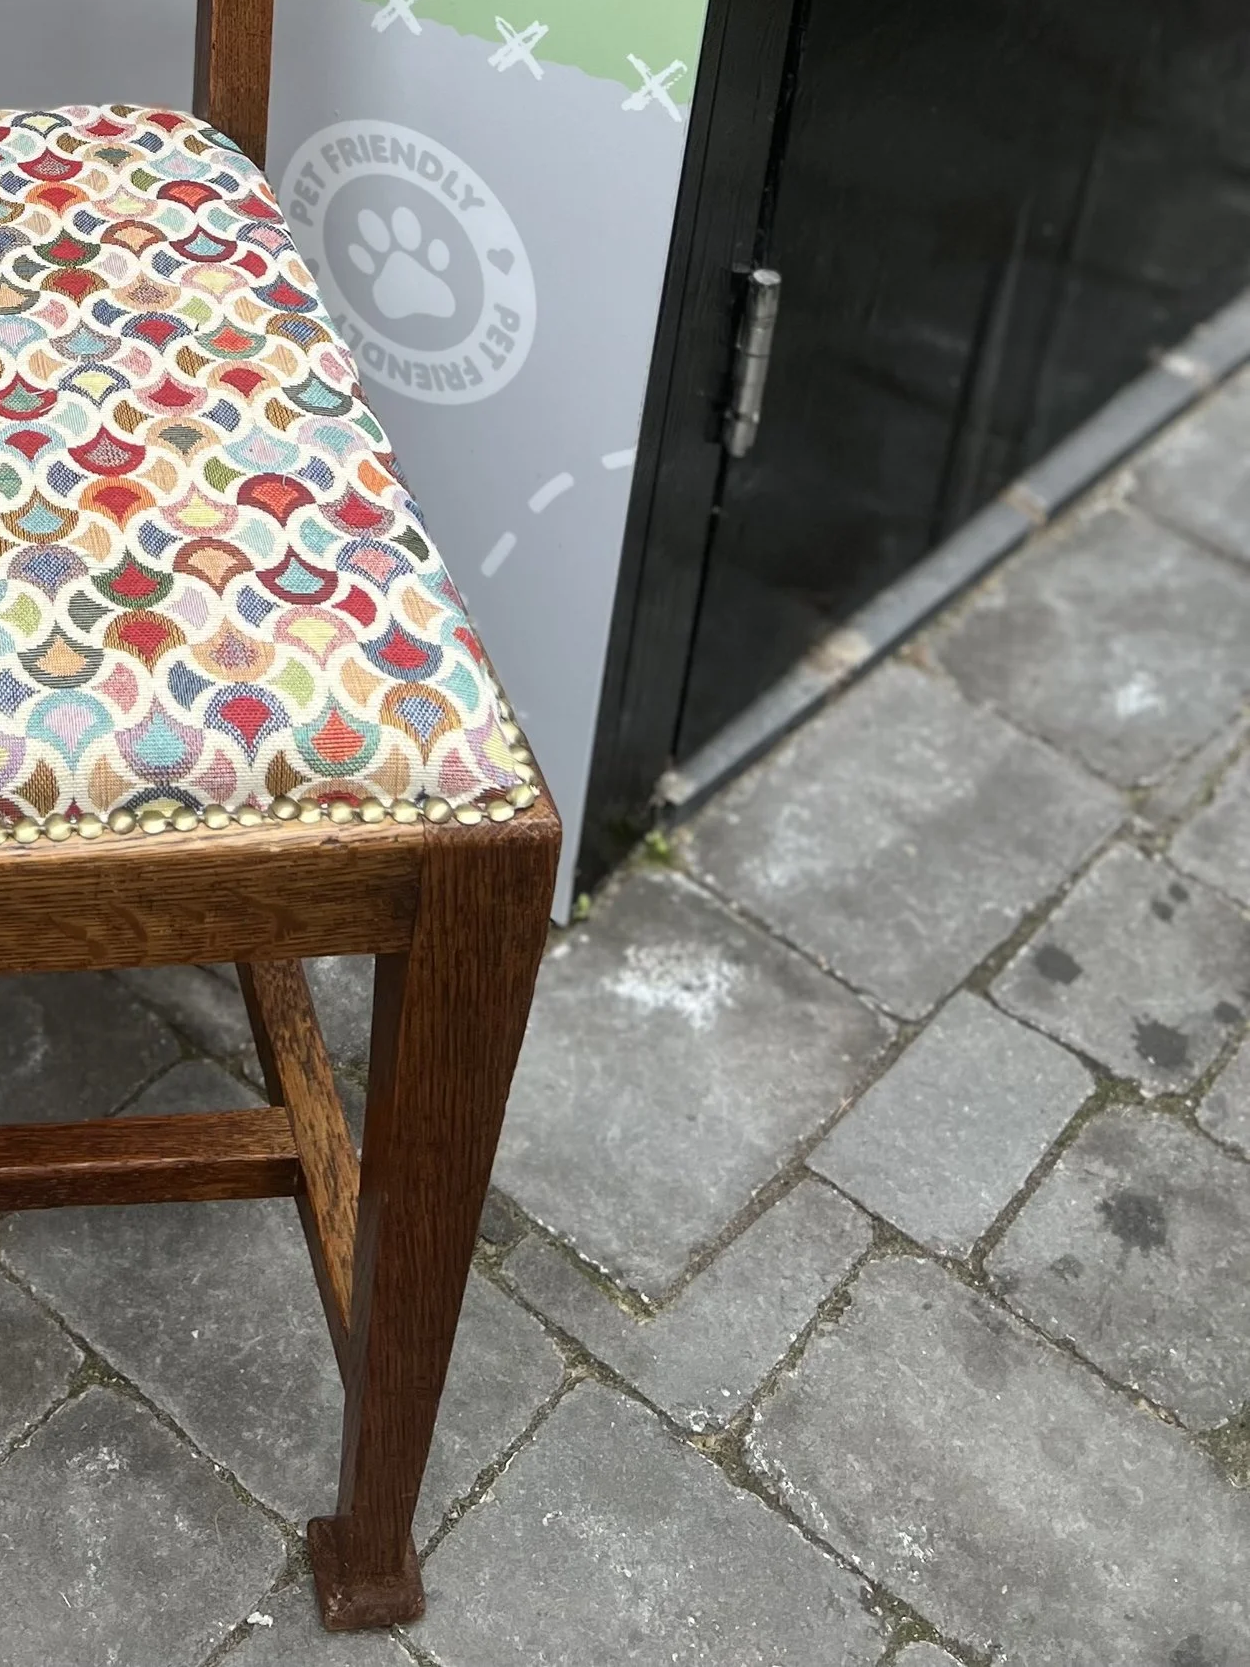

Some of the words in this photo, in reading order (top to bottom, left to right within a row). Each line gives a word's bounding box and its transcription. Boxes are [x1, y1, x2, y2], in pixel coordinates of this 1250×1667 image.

[289, 161, 325, 227] PET
[320, 134, 486, 211] FRIENDLY
[478, 303, 521, 371] PET
